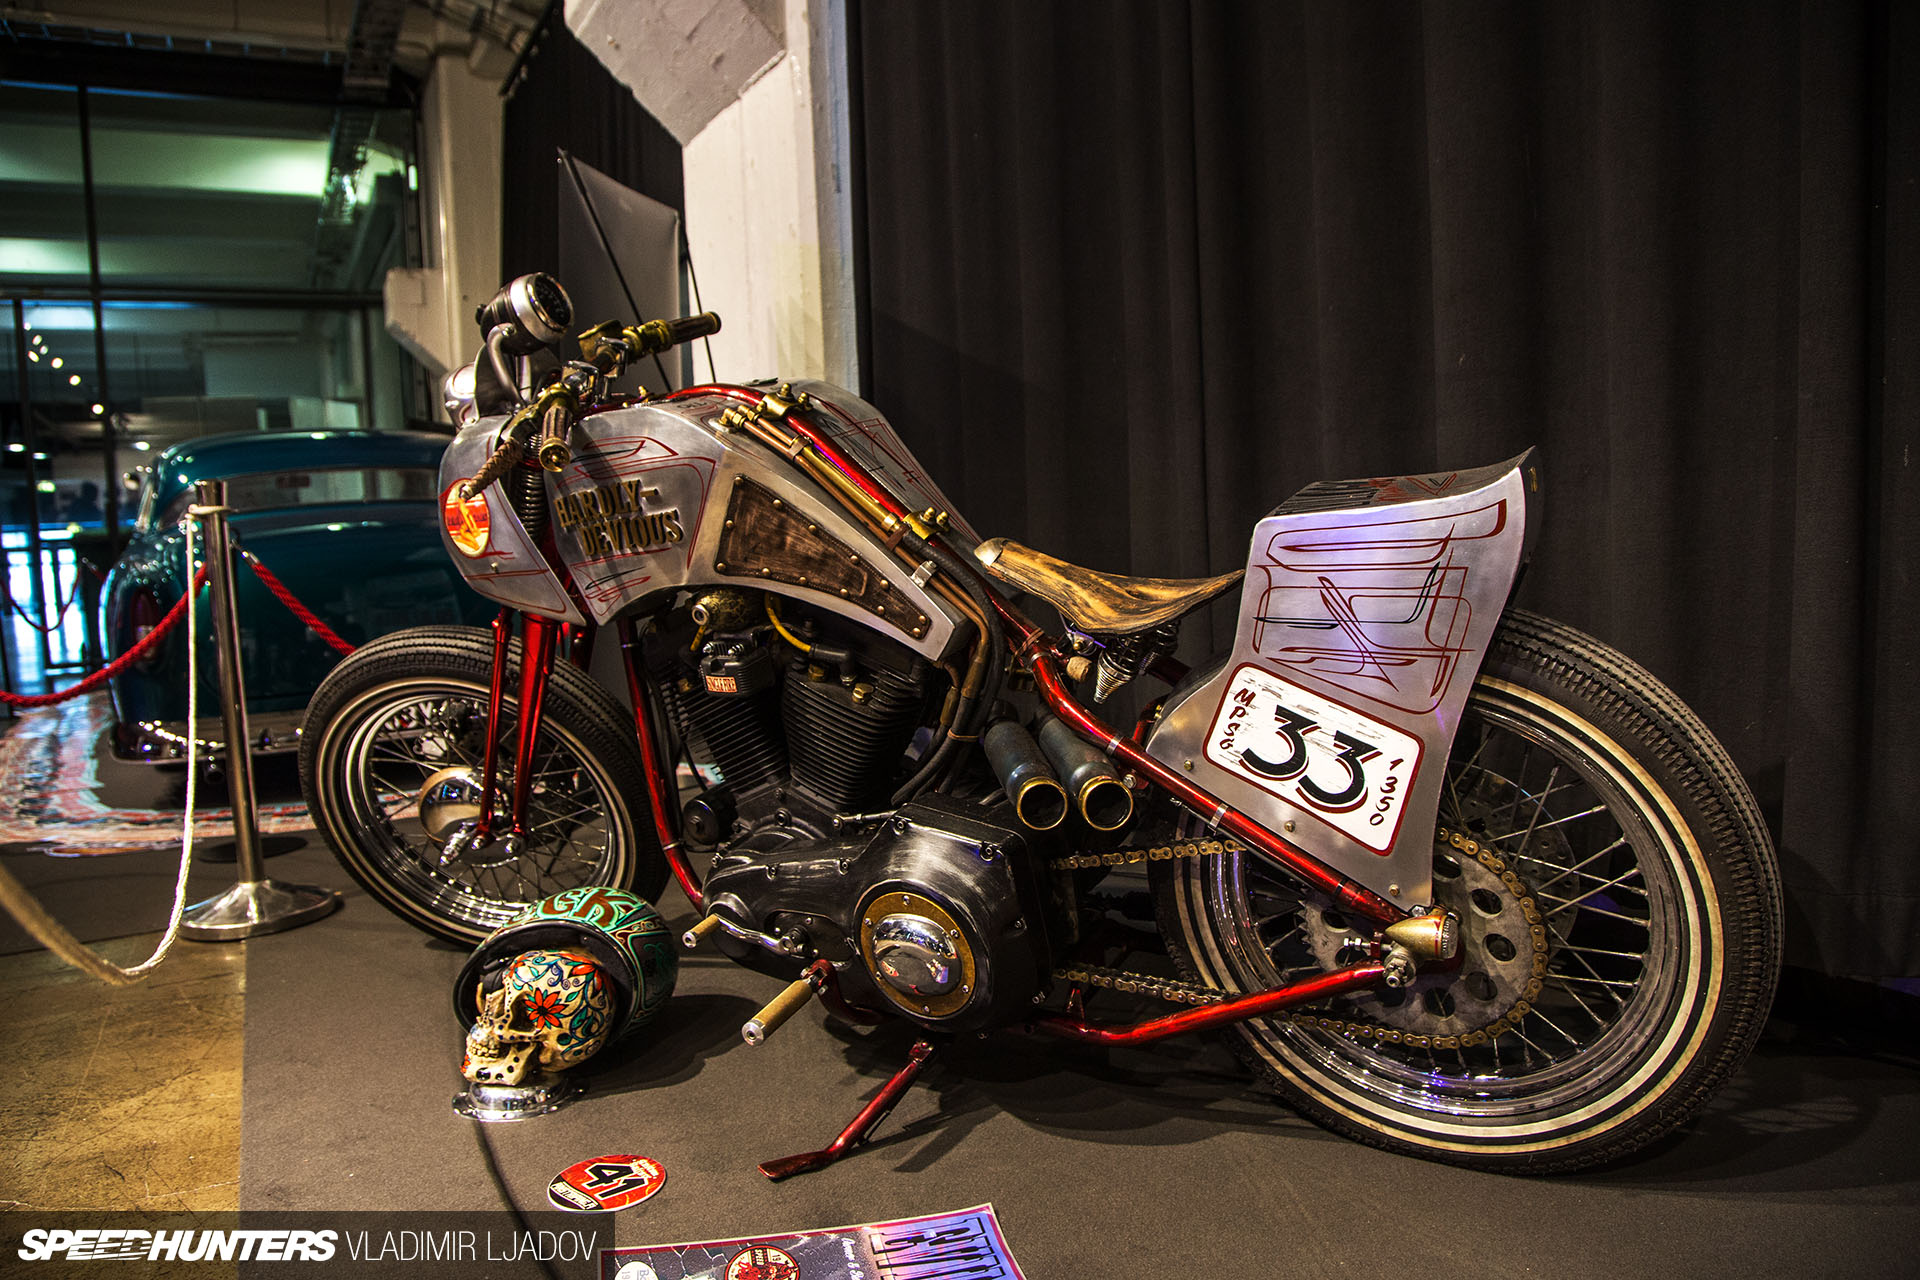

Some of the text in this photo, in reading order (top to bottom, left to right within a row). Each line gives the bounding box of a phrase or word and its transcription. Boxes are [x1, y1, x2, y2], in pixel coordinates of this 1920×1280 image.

[554, 480, 659, 529] HARDLY-
[581, 509, 684, 556] DEVIOUS
[1239, 704, 1383, 814] 33
[1369, 758, 1405, 826] 1350
[581, 1163, 648, 1200] 41
